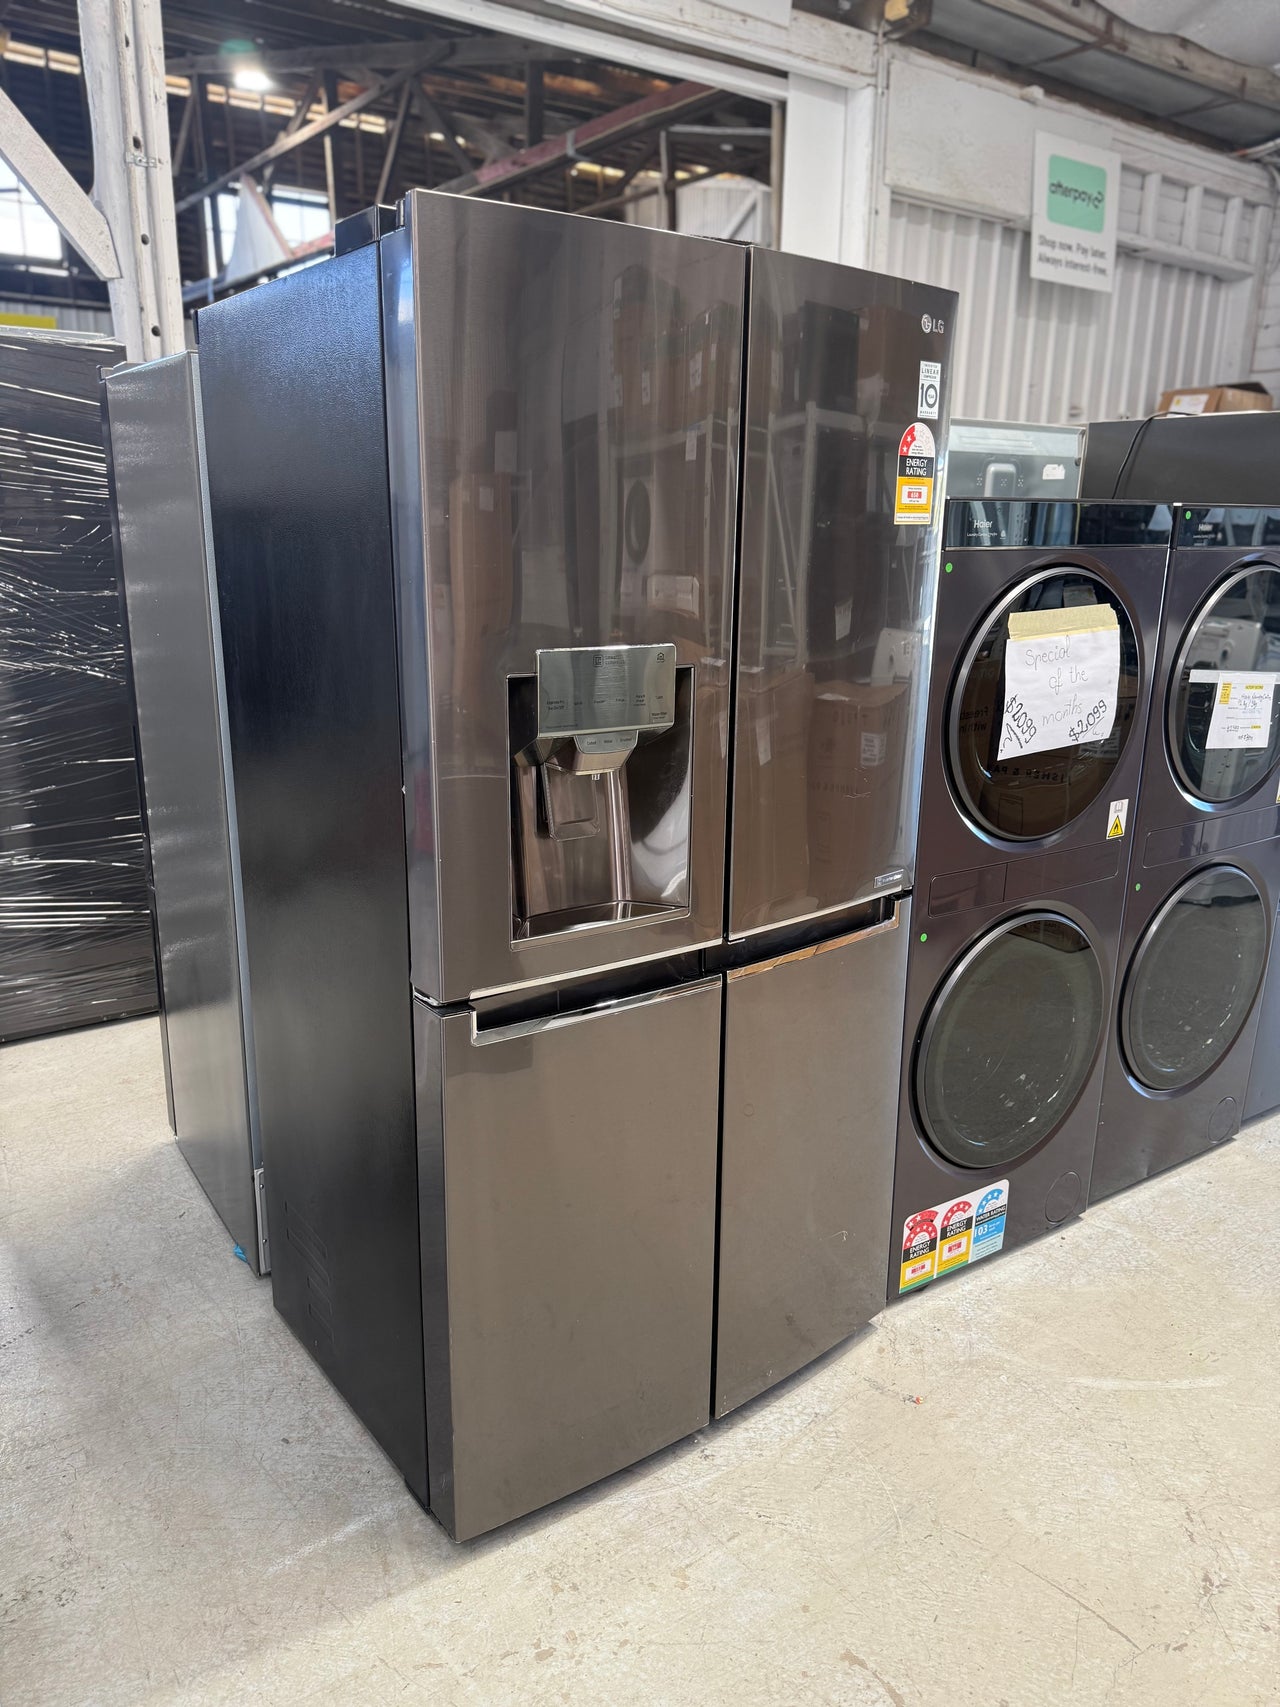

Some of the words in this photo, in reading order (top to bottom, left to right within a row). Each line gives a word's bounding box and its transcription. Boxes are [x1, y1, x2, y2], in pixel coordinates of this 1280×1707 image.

[1038, 234, 1056, 250] Shop
[1076, 242, 1089, 256] Pay
[1037, 252, 1062, 268] Always
[932, 318, 945, 334] LG
[921, 368, 939, 376] LINEAR
[920, 383, 938, 408] 10
[906, 458, 928, 468] ENERGY
[905, 467, 927, 476] RATING
[973, 519, 993, 529] Haier
[1025, 635, 1072, 671] Special
[1048, 667, 1064, 695] of
[1069, 665, 1089, 684] the
[1042, 693, 1083, 727] months
[1005, 693, 1037, 744] $2099
[1068, 699, 1108, 742] $2099
[946, 1219, 968, 1232] ENERGY
[946, 1226, 967, 1238] RATING
[974, 1224, 988, 1238] 103
[909, 1240, 931, 1254] ENERGY
[909, 1247, 930, 1260] RATING
